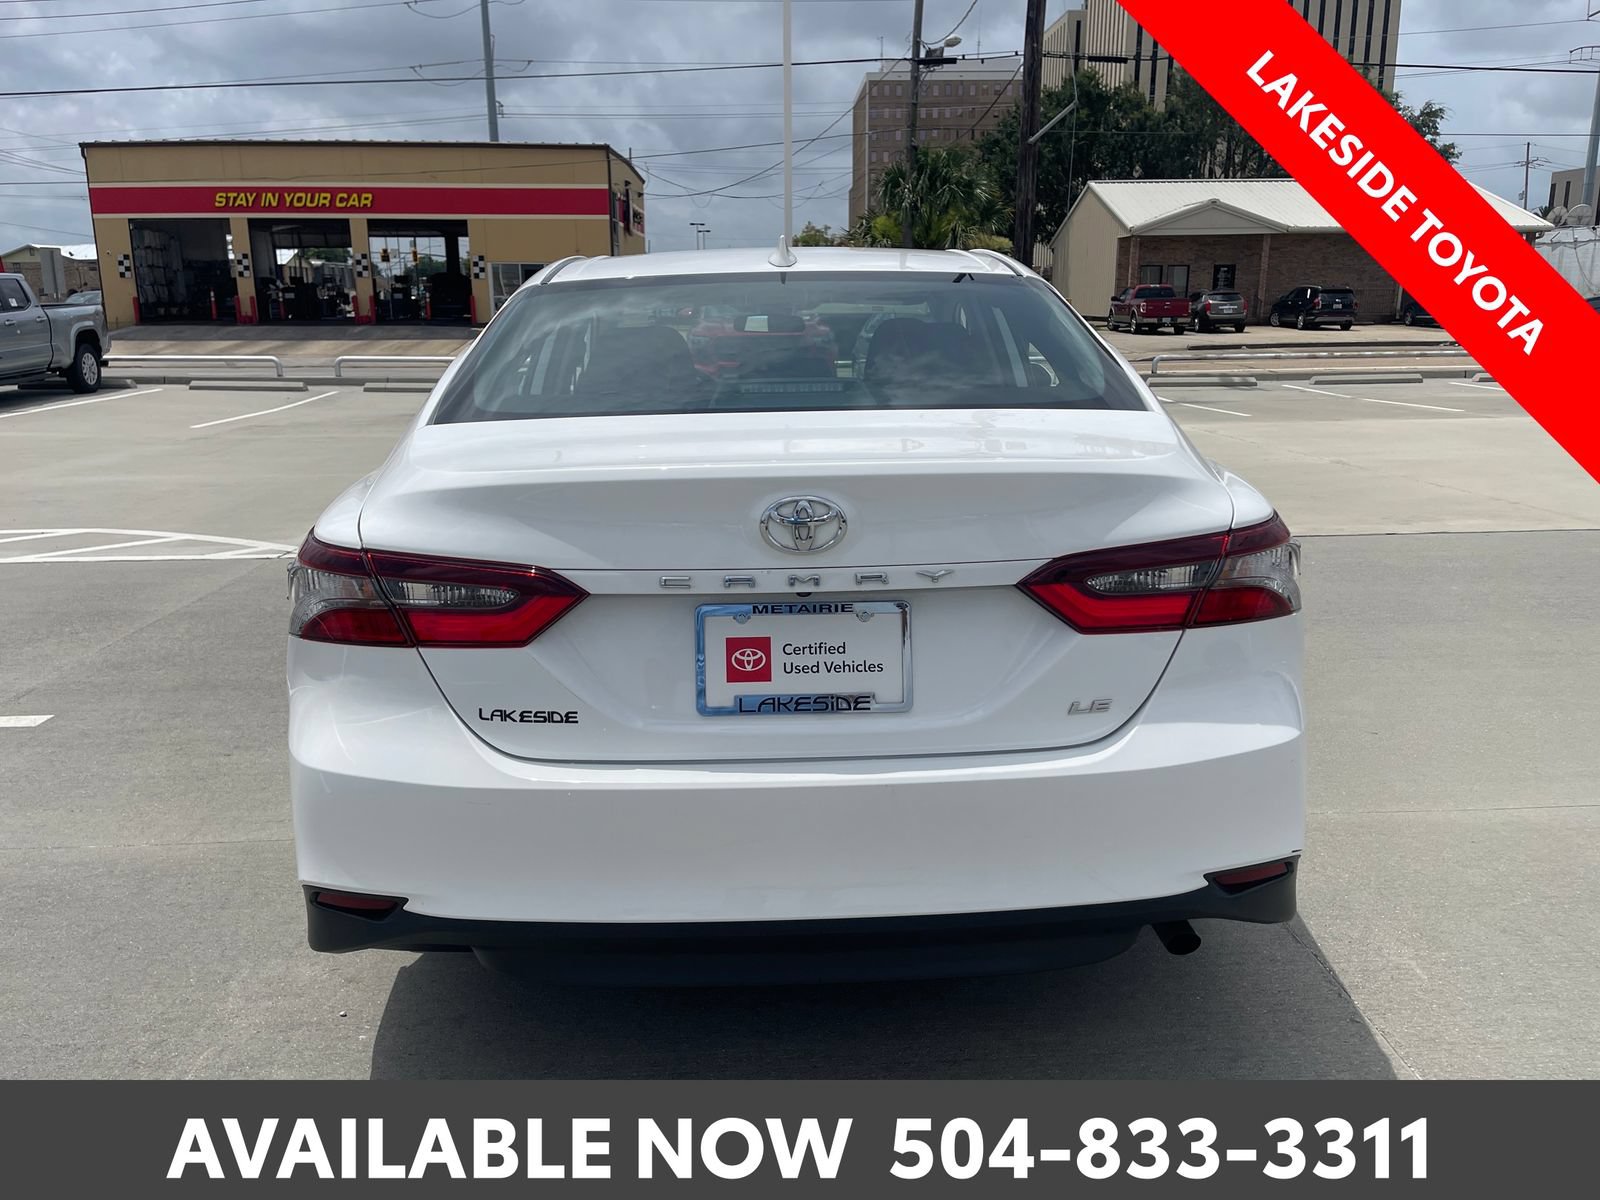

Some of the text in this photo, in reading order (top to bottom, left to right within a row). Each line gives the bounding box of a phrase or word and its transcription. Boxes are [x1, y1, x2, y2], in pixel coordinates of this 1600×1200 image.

[214, 192, 374, 208] STAY IN YOUR CAR
[659, 568, 955, 589] CAMRY
[752, 603, 854, 615] METAIRIE
[782, 641, 847, 656] Certified
[783, 659, 885, 675] Used Vehicles
[1067, 698, 1113, 715] LE
[478, 707, 579, 724] LAKESIDE
